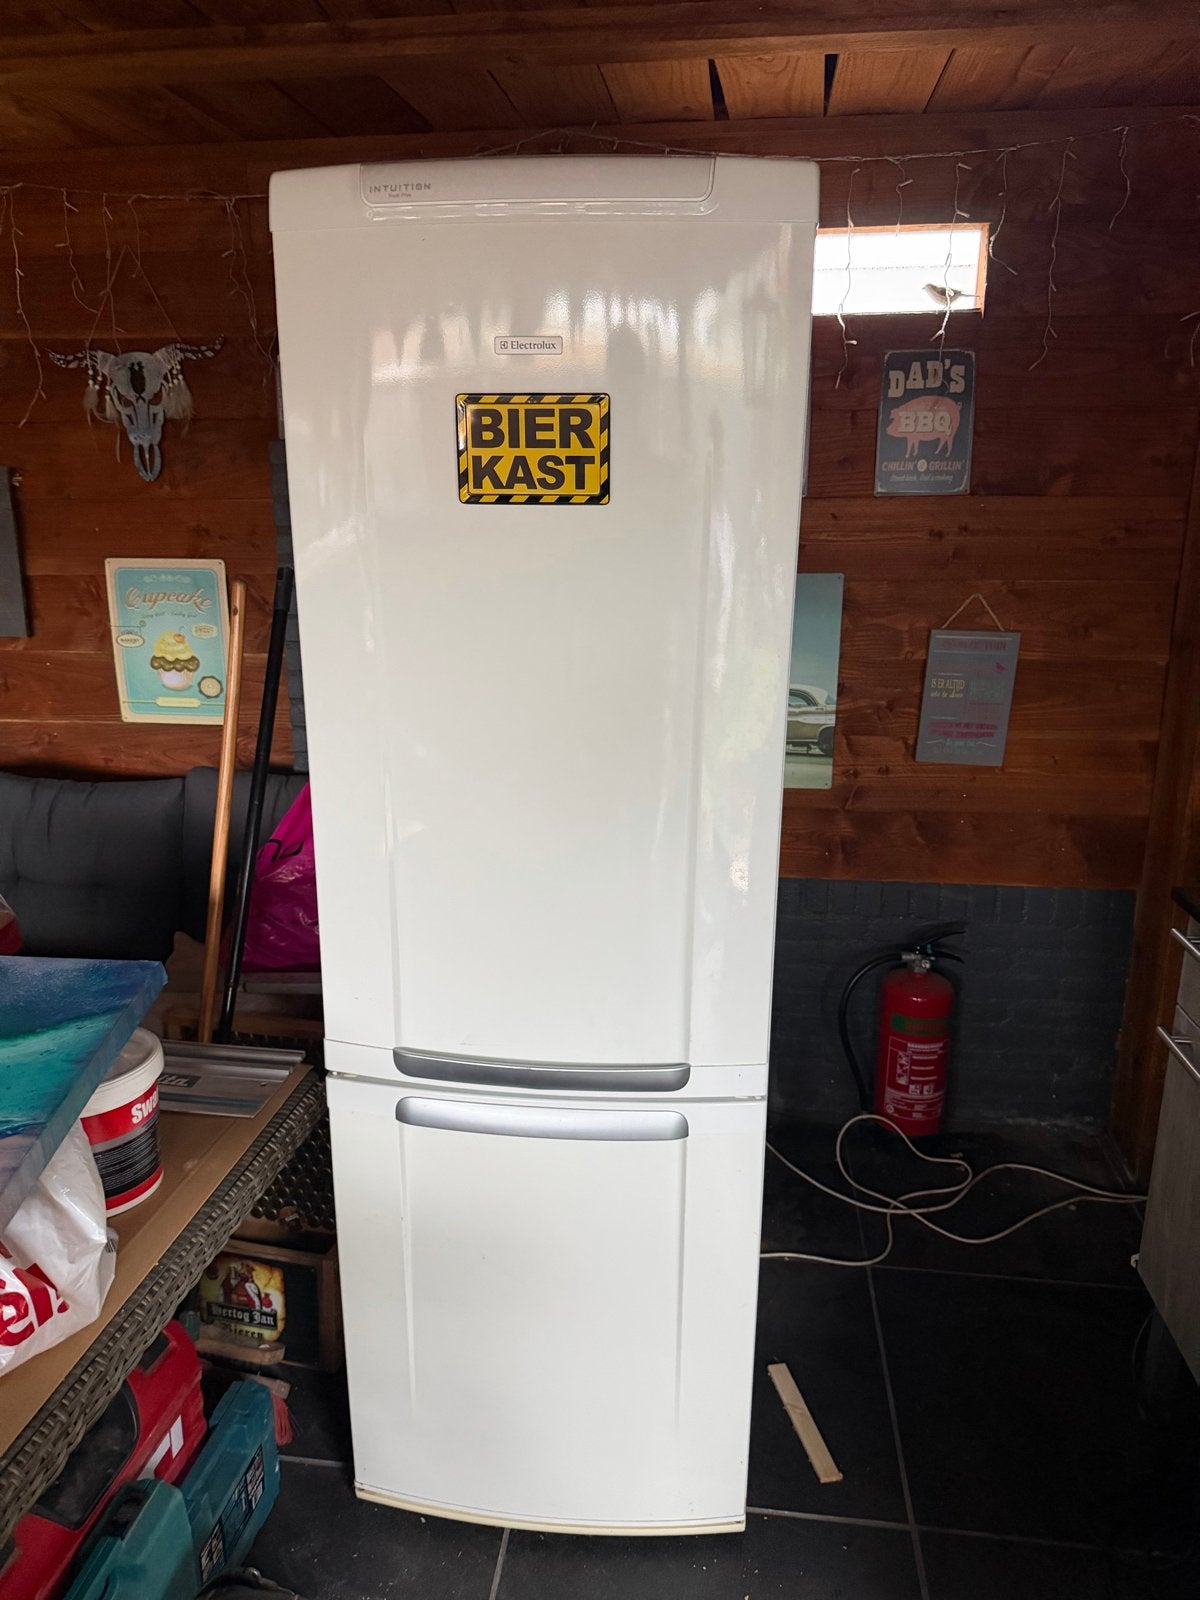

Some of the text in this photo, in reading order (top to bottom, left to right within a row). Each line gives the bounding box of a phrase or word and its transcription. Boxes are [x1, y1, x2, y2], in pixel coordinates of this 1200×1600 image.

[369, 183, 431, 193] INTUITION
[511, 341, 557, 350] Electrolux
[888, 359, 966, 398] DAD'S
[471, 408, 595, 449] BIER
[897, 411, 952, 436] BBQ
[471, 455, 595, 491] KAST
[126, 587, 212, 614] Cupcake
[252, 1310, 275, 1326] Jan
